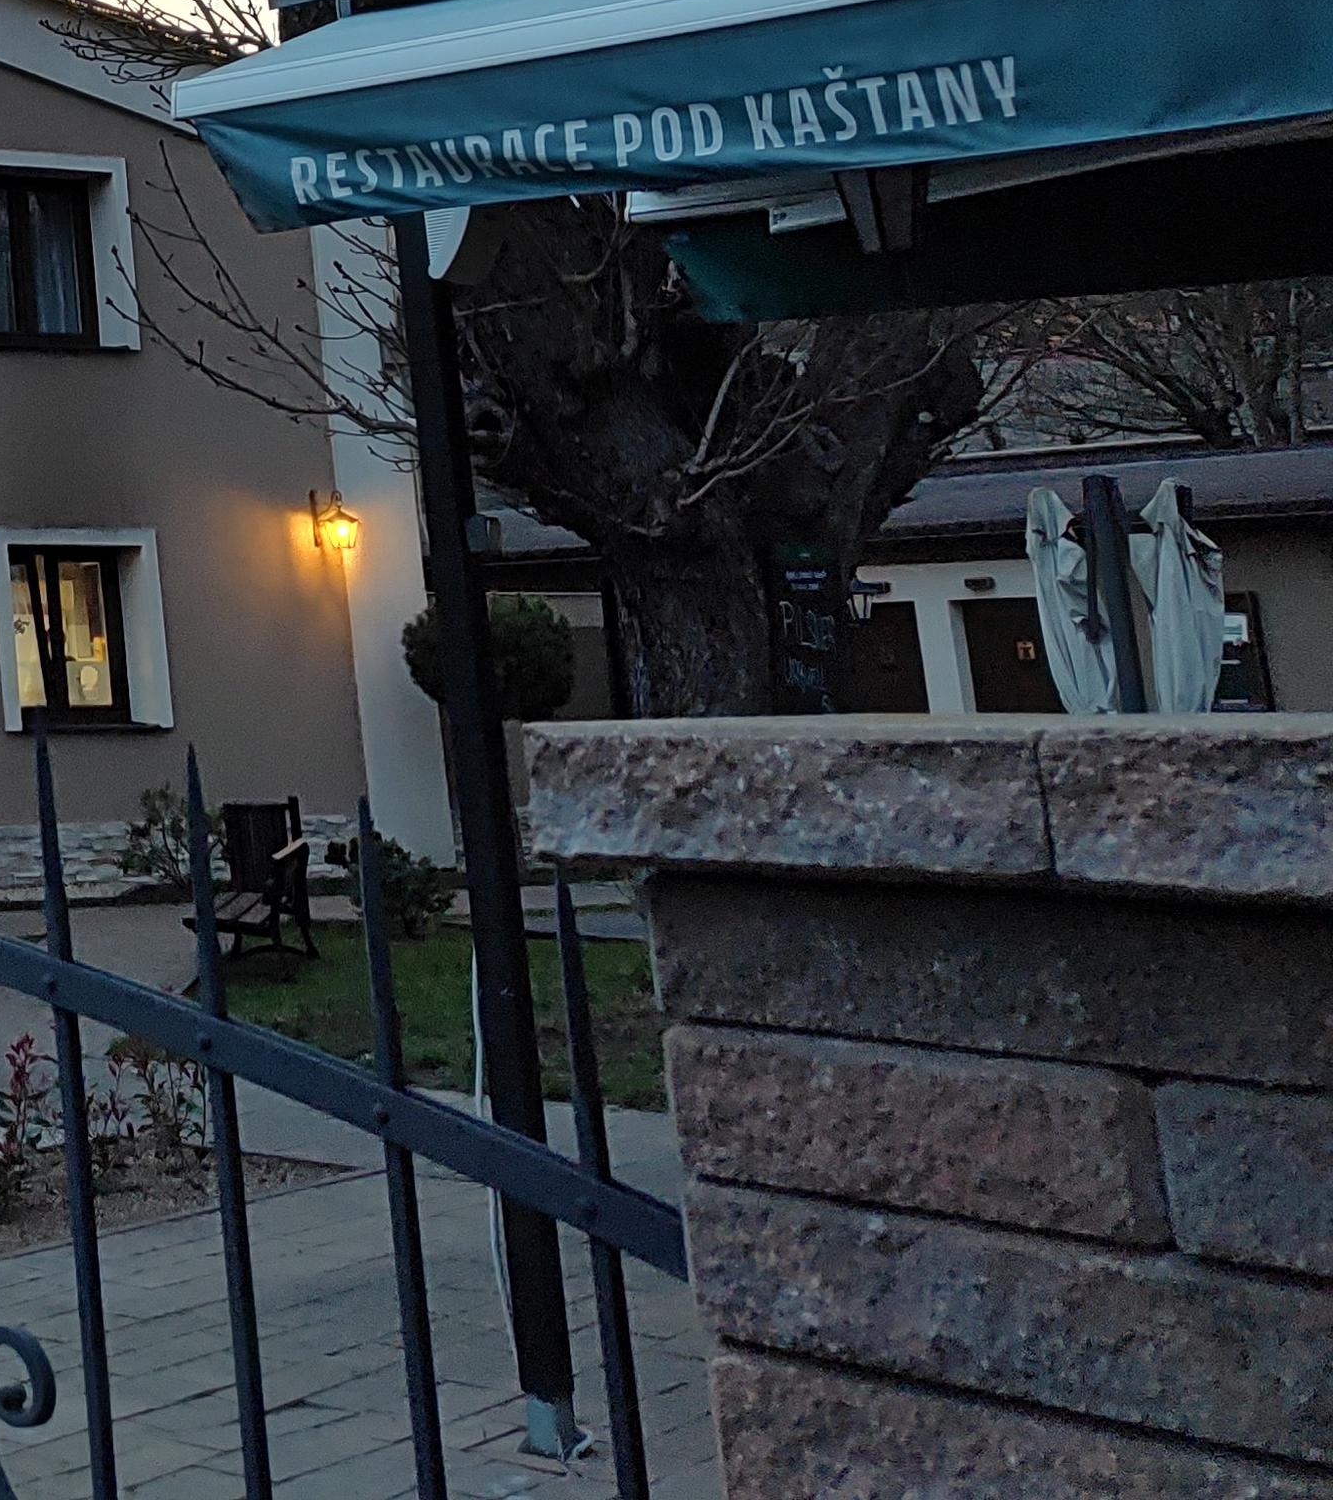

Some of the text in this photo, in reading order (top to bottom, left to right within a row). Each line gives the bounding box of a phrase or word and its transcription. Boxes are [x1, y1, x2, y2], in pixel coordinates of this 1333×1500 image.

[290, 56, 1016, 205] RESTAURACE POD KAŠTANY
